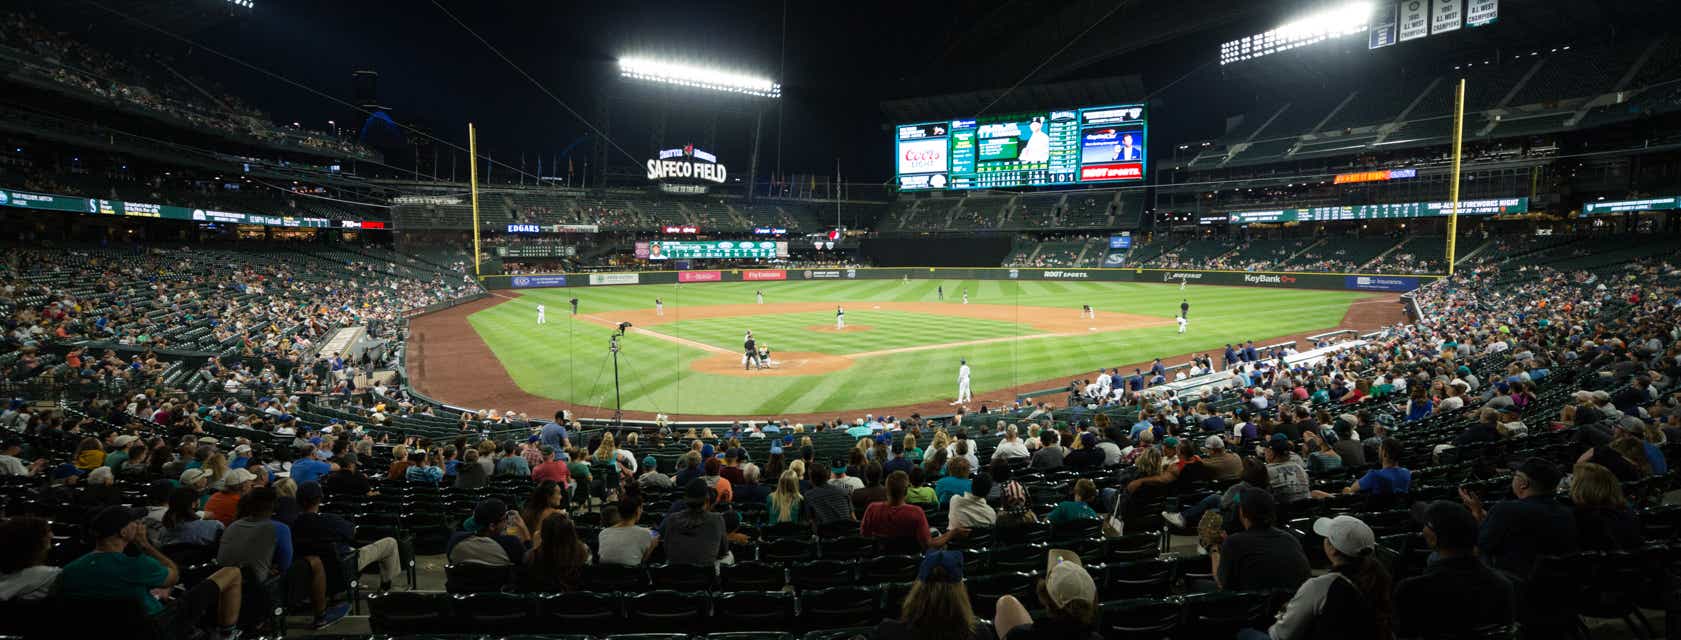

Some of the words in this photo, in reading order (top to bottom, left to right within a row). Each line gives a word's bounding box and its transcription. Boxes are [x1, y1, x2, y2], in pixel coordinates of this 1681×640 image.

[1481, 3, 1495, 11] WEST
[1445, 12, 1457, 20] WEST
[1468, 11, 1496, 22] CHAMPIONS
[1433, 19, 1459, 31] CHAMPIONS
[647, 158, 692, 180] SAFECO
[693, 162, 727, 183] FIELD
[507, 225, 540, 234] EDGARS
[1043, 271, 1063, 279] ROOT
[1244, 274, 1281, 284] KeyBank
